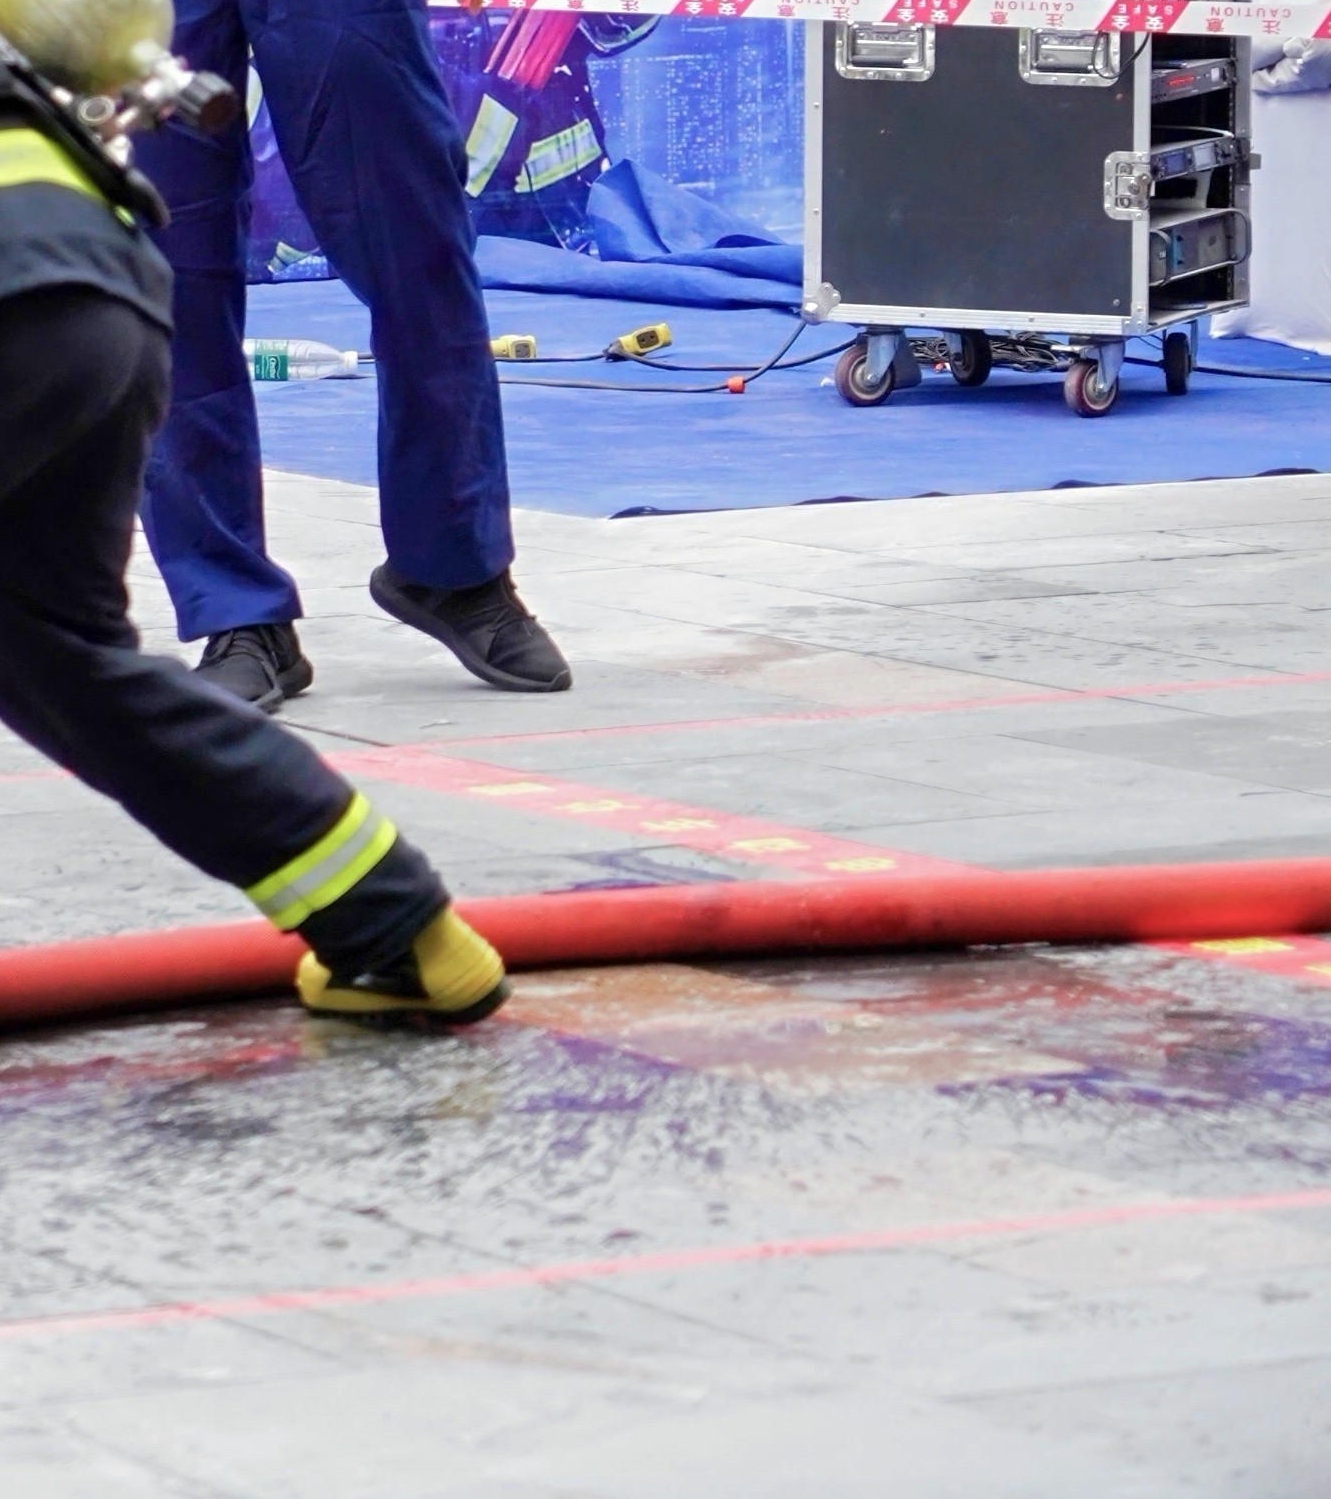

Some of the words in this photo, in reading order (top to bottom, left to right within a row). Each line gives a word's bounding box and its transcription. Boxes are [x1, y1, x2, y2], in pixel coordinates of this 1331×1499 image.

[685, 1, 738, 16] 安全
[777, 4, 851, 20] 注意
[994, 1, 1075, 13] CAUTION
[1118, 3, 1174, 15] SAFE
[1210, 7, 1291, 18] CAUTION
[896, 8, 949, 24] 安全
[990, 11, 1065, 27] 注意
[1110, 14, 1164, 31] 安全
[1205, 18, 1282, 35] 注意
